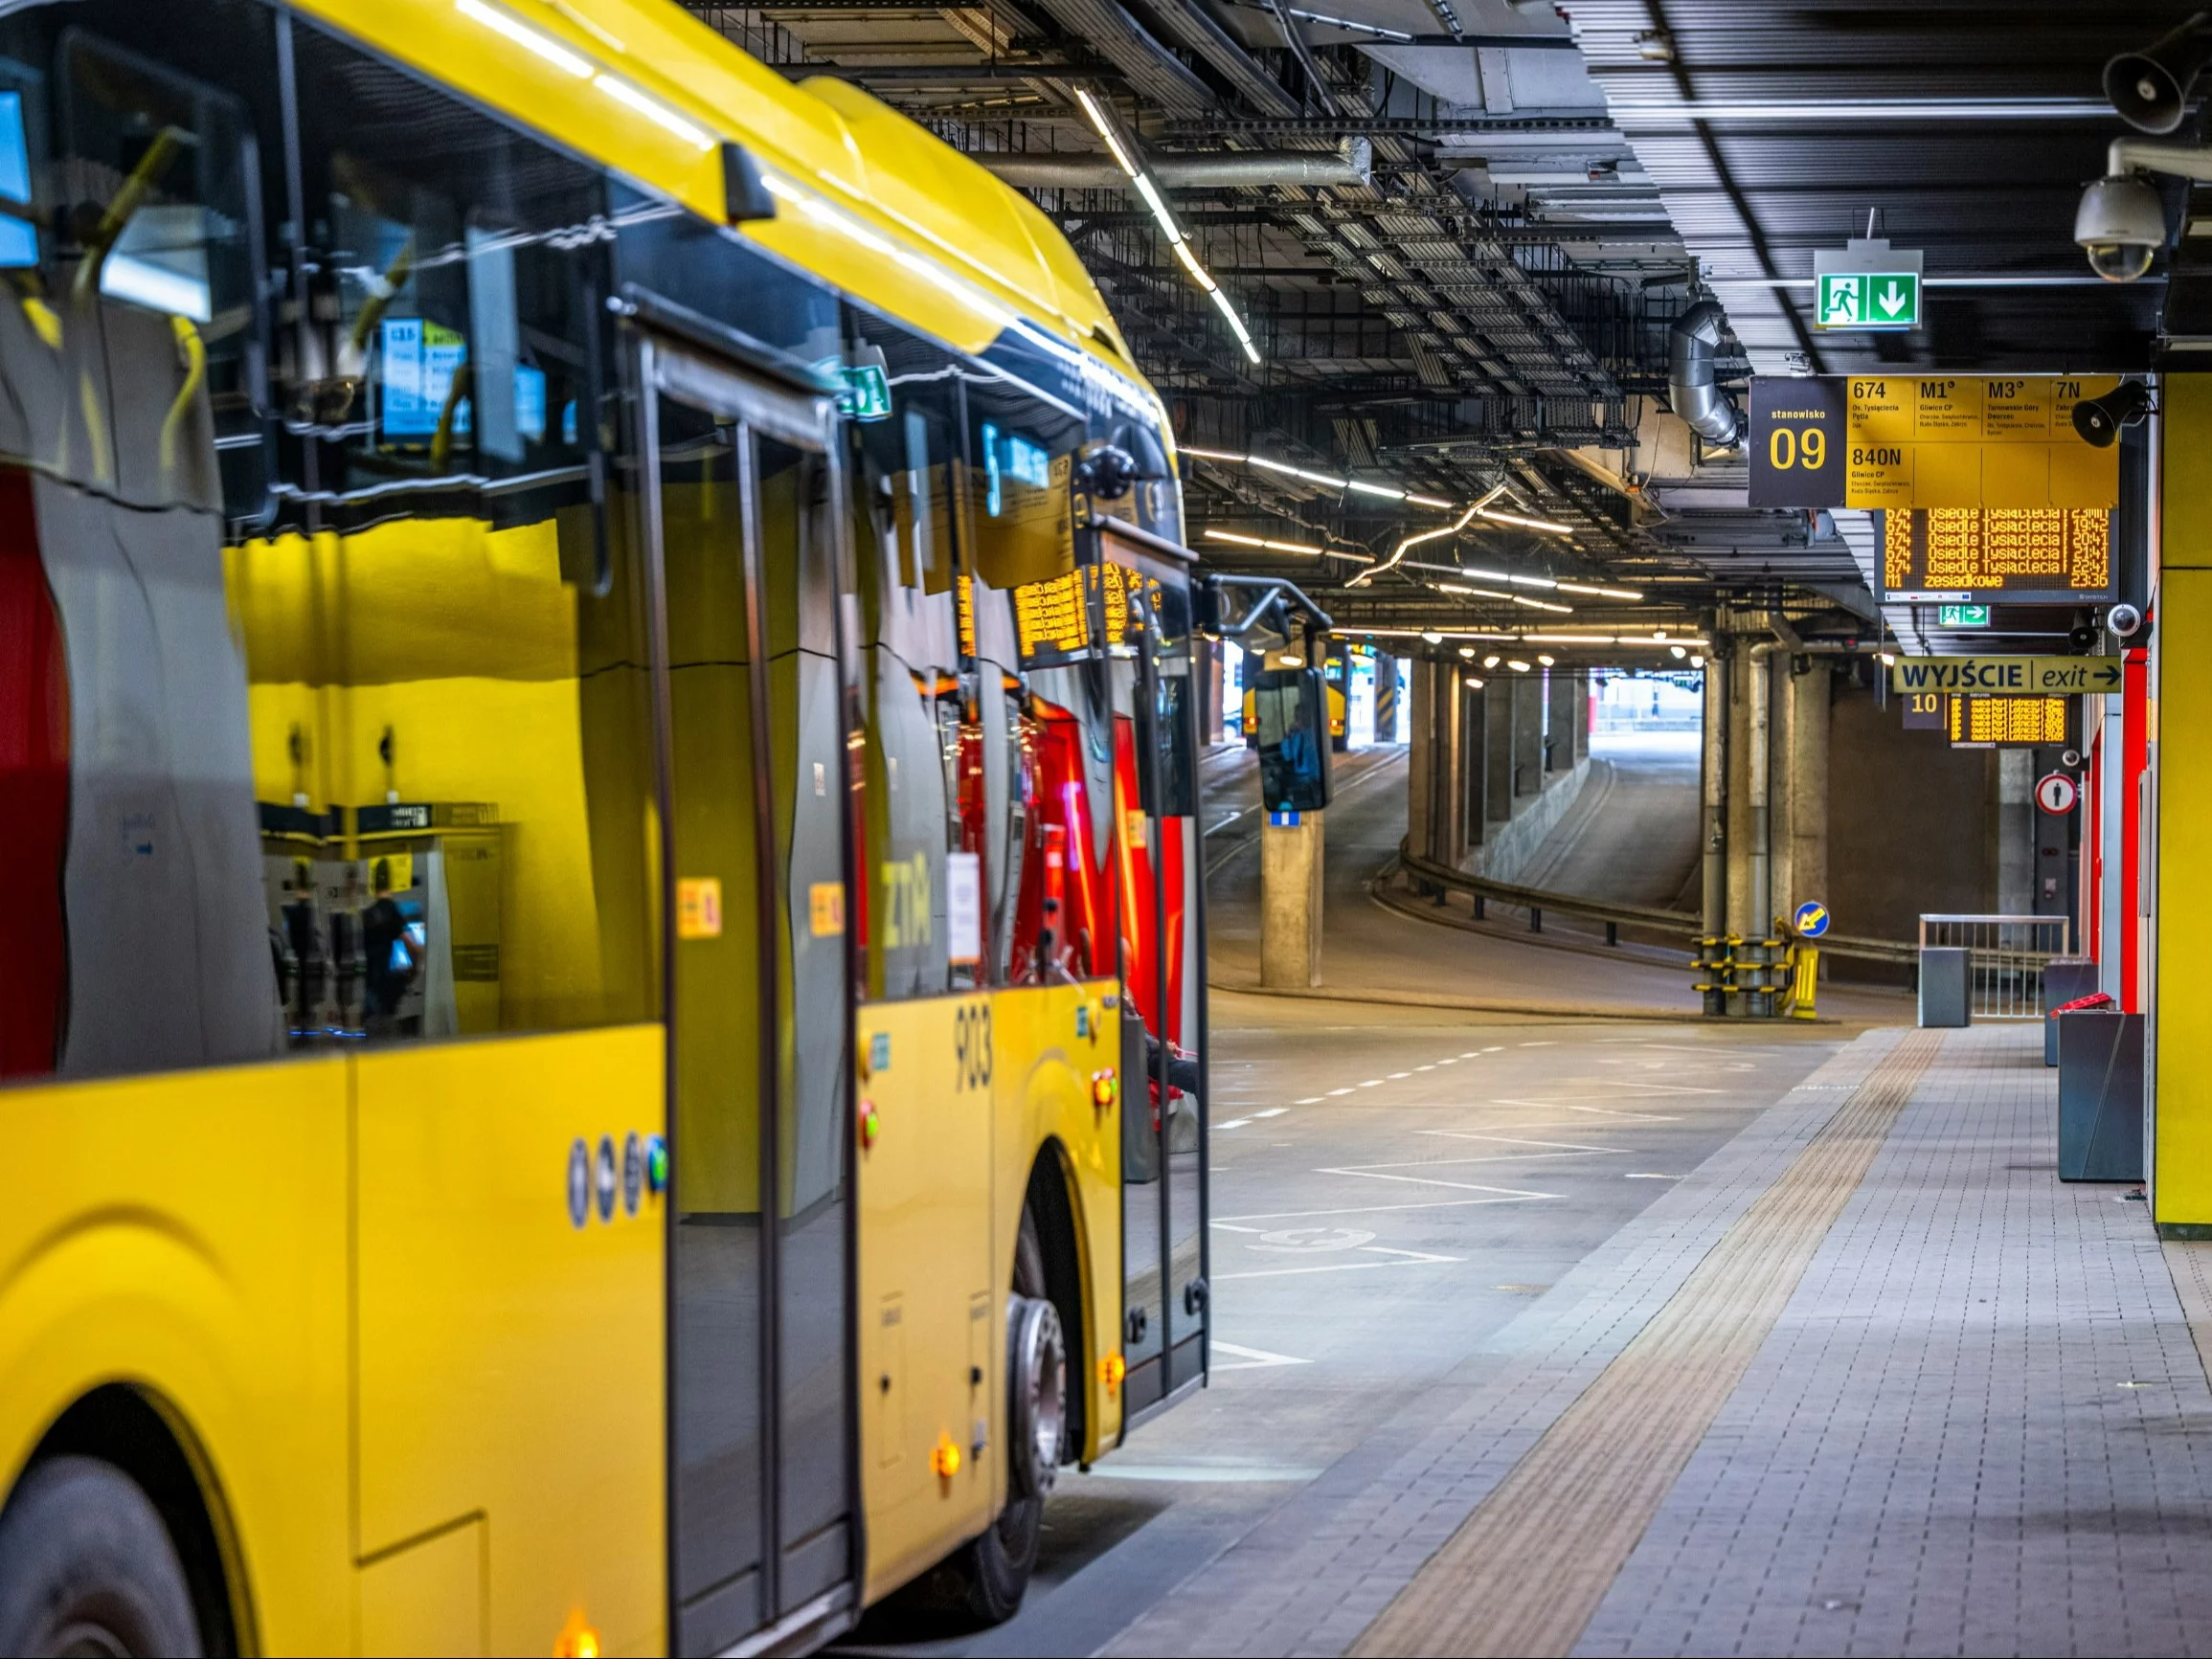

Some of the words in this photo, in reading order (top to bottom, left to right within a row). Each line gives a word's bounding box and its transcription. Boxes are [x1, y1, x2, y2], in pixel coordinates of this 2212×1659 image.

[1853, 382, 1886, 399] 674
[2056, 382, 2081, 399] 7N
[1772, 409, 1826, 419] stanowisko
[1852, 413, 1869, 421] Pętla
[1770, 427, 1826, 470] 09
[1852, 448, 1902, 466] 840N
[1885, 519, 1911, 532] 674
[1929, 519, 1979, 532] Osiedle
[2072, 519, 2109, 532] 19:42
[1885, 532, 1911, 546] 674
[1929, 532, 1979, 546] Osiedle
[2072, 532, 2109, 546] 20:41
[1885, 546, 1911, 560] 674
[1929, 546, 1979, 560] Osiedle
[2072, 546, 2109, 560] 21:41
[1885, 559, 1911, 573] 674
[1929, 559, 1979, 573] Osiedle
[2072, 559, 2109, 573] 22:41
[1885, 573, 1902, 588] M1
[2071, 572, 2109, 588] 23:36
[1903, 660, 2023, 687] WYJŚCIE
[2042, 665, 2088, 687] exit
[1911, 693, 1937, 713] 10
[955, 1005, 993, 1094] 903
